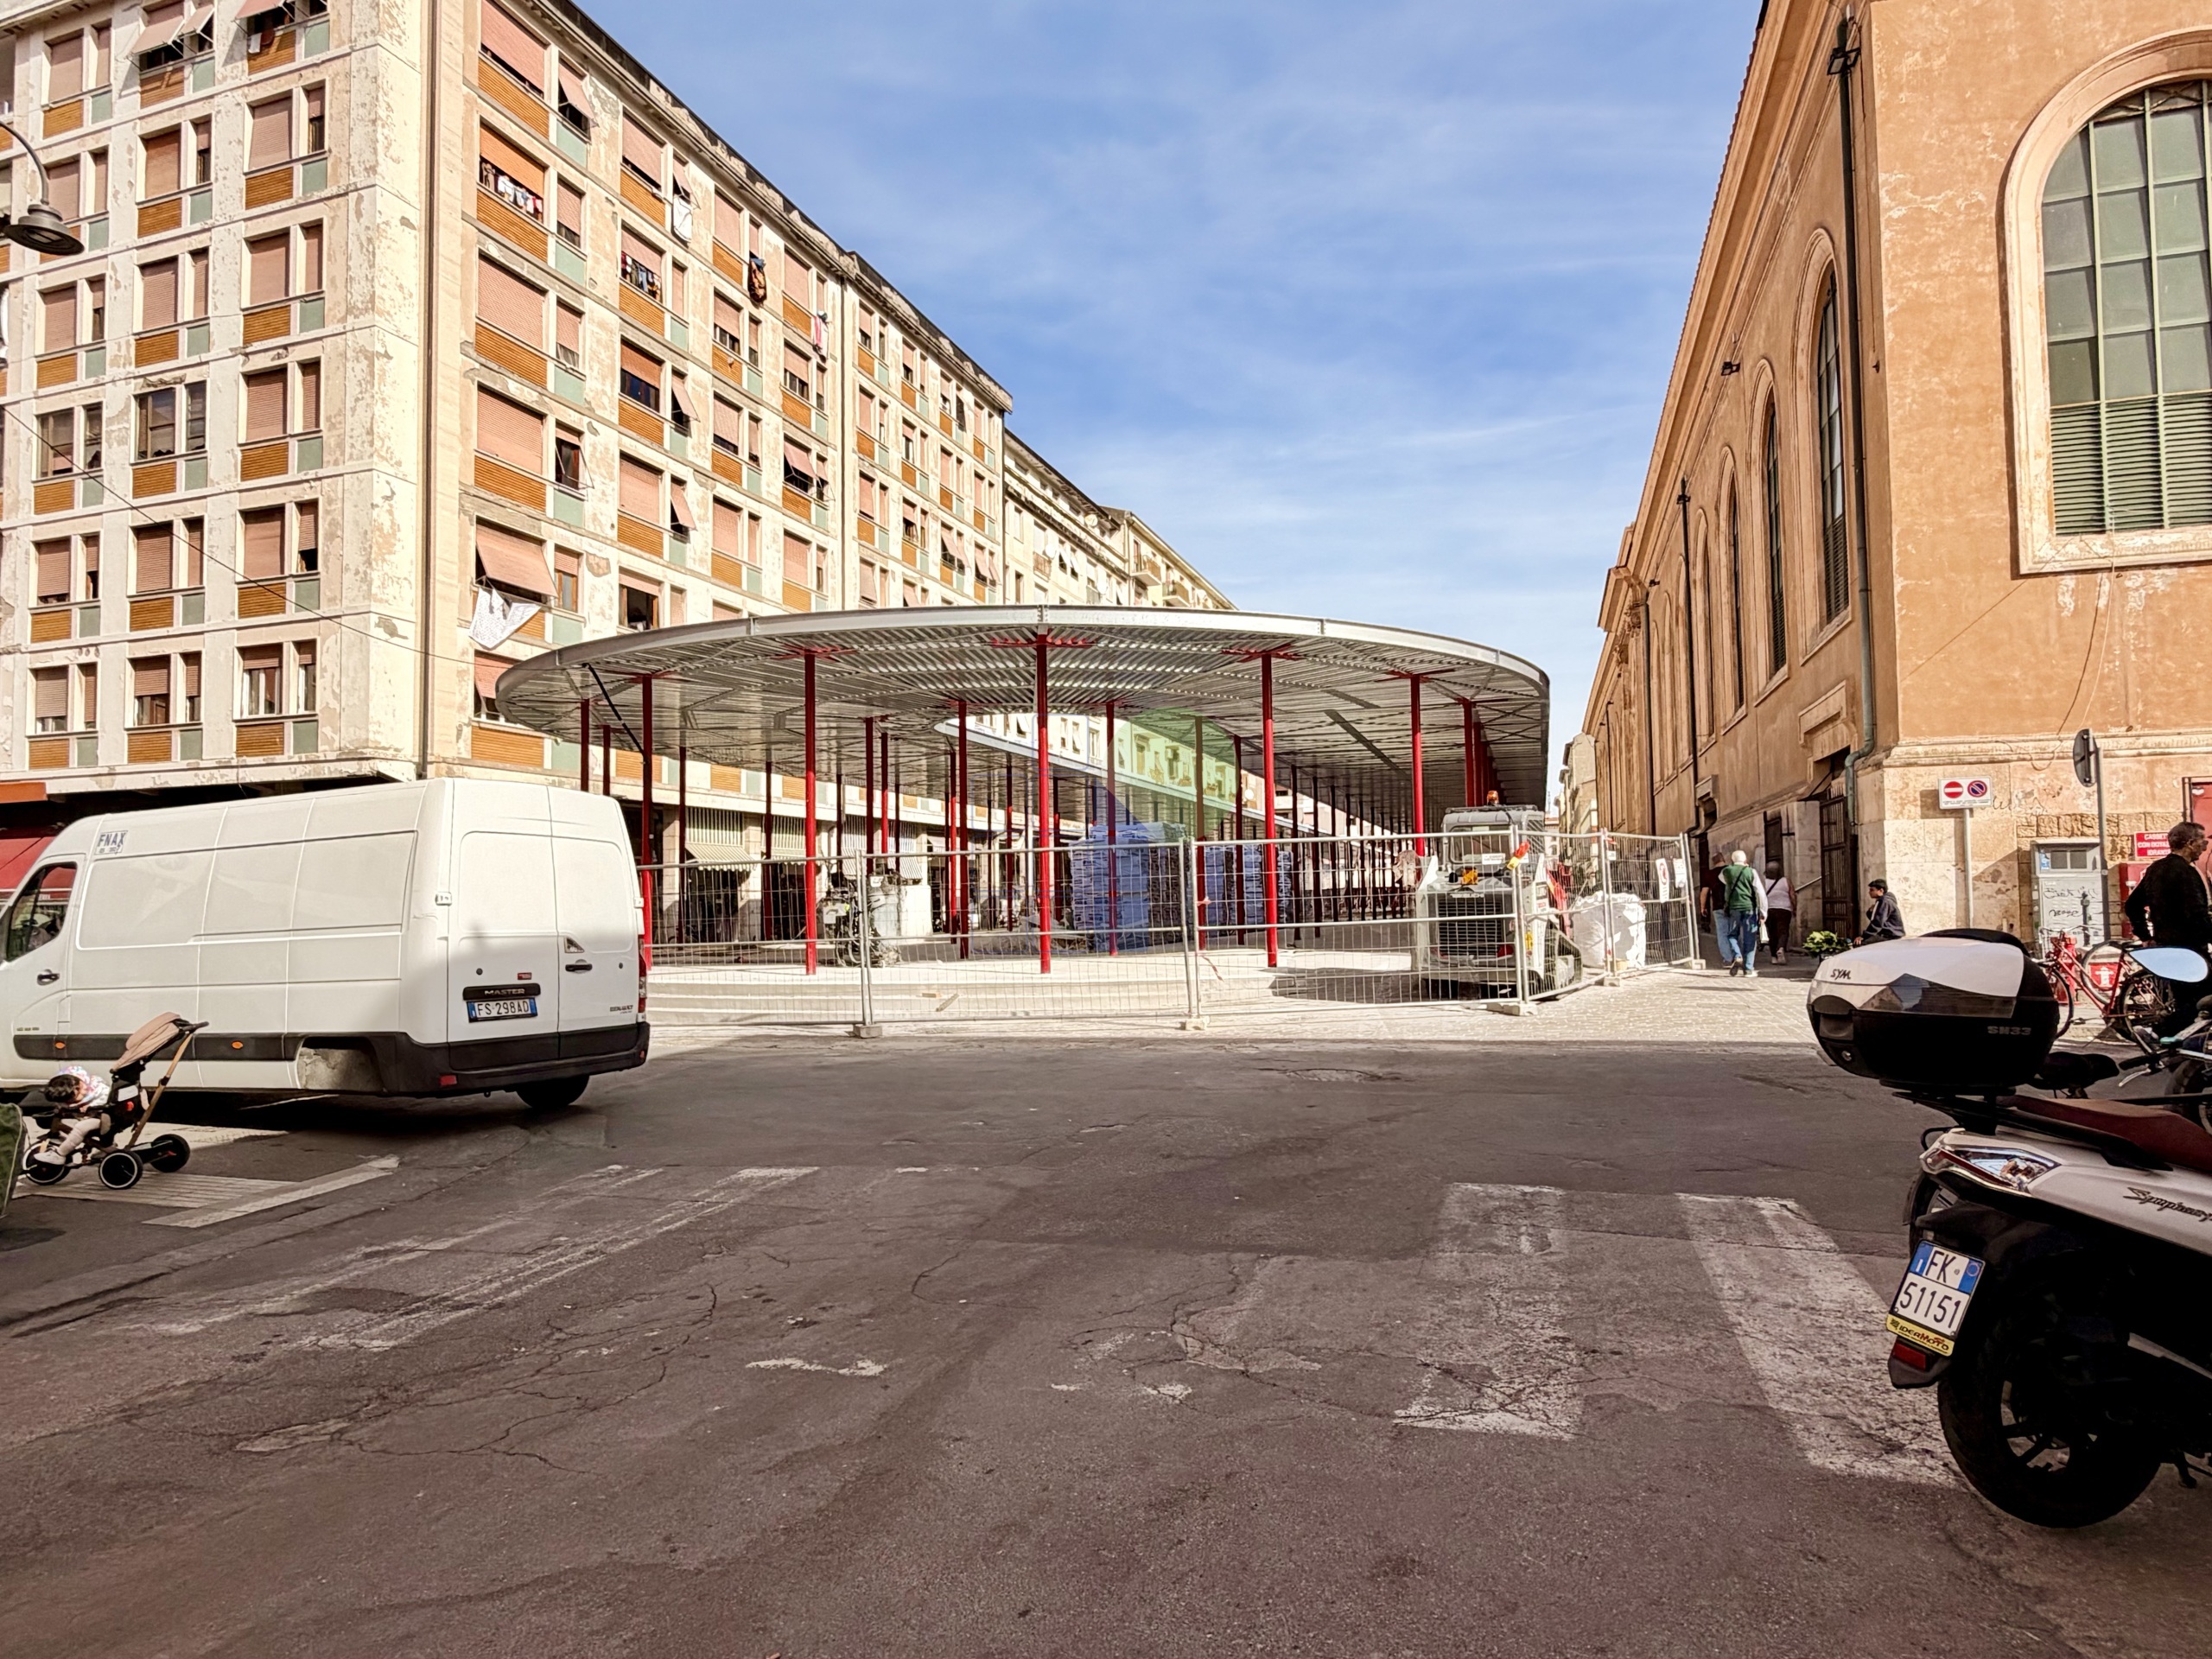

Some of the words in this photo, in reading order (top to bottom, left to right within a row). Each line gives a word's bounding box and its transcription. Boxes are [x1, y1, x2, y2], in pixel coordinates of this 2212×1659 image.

[97, 832, 126, 847] FNAX
[1830, 969, 1852, 981] SYM
[1925, 1249, 1956, 1284] FK
[1900, 1281, 1961, 1329] 51151
